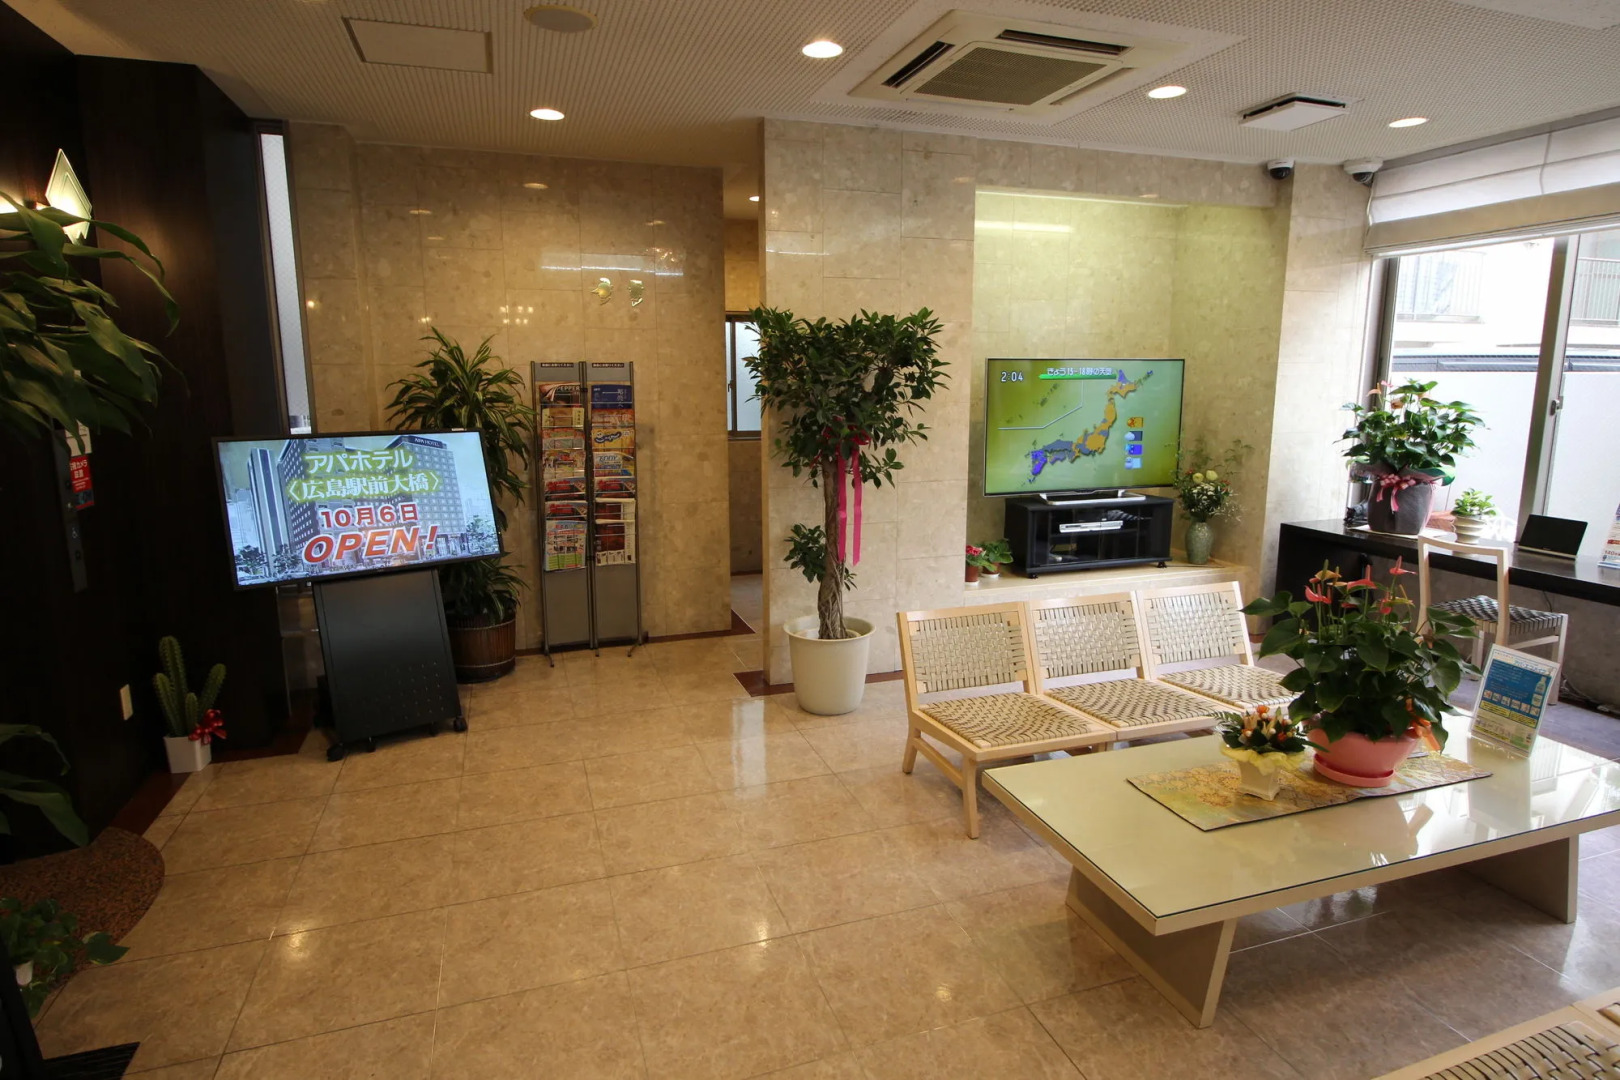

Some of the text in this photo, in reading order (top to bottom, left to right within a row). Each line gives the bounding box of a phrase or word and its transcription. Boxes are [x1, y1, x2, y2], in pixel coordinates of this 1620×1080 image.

[1001, 371, 1024, 382] 2:04
[305, 449, 413, 474] アパホテル
[320, 503, 419, 529] 10月6日
[303, 525, 438, 563] OPEN!
